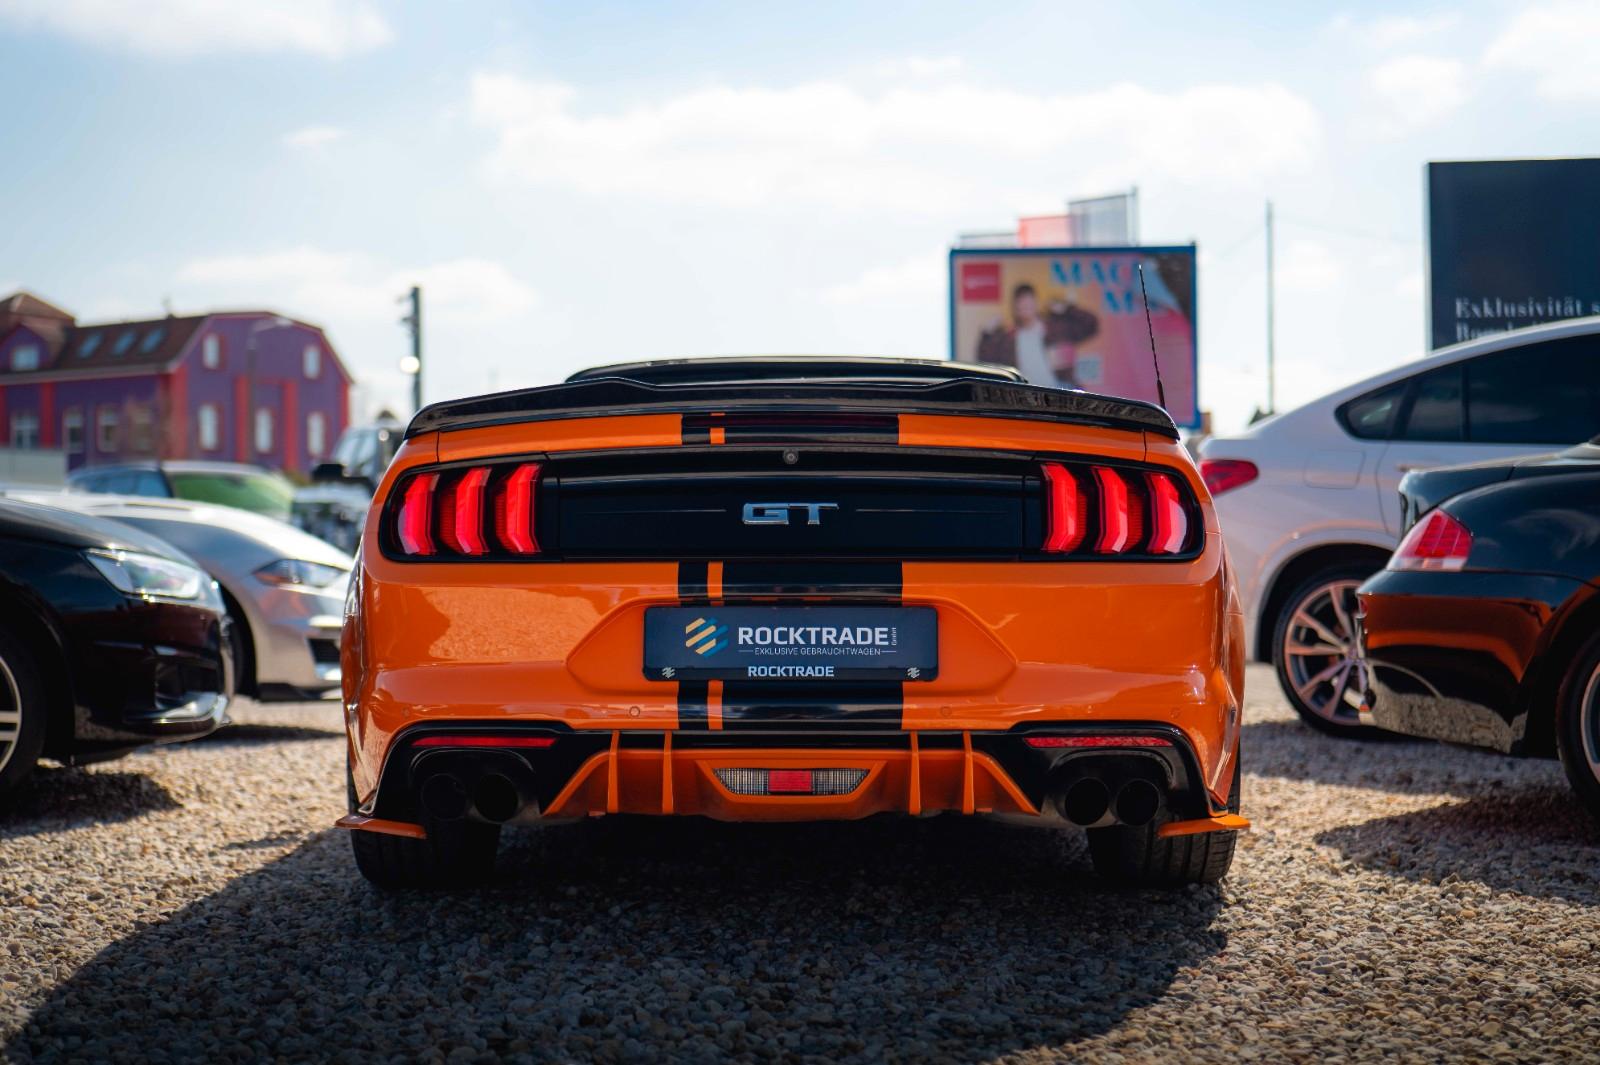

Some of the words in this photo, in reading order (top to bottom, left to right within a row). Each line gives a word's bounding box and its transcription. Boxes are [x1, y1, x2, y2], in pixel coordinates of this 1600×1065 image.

[1456, 297, 1582, 318] Exklusivität
[743, 503, 839, 525] GT
[738, 627, 889, 645] ROCKTRADE
[754, 647, 798, 655] EXKLUSIVE
[800, 647, 881, 656] GEBRAUCHTWAGEN
[747, 665, 835, 677] ROCKTRADE
